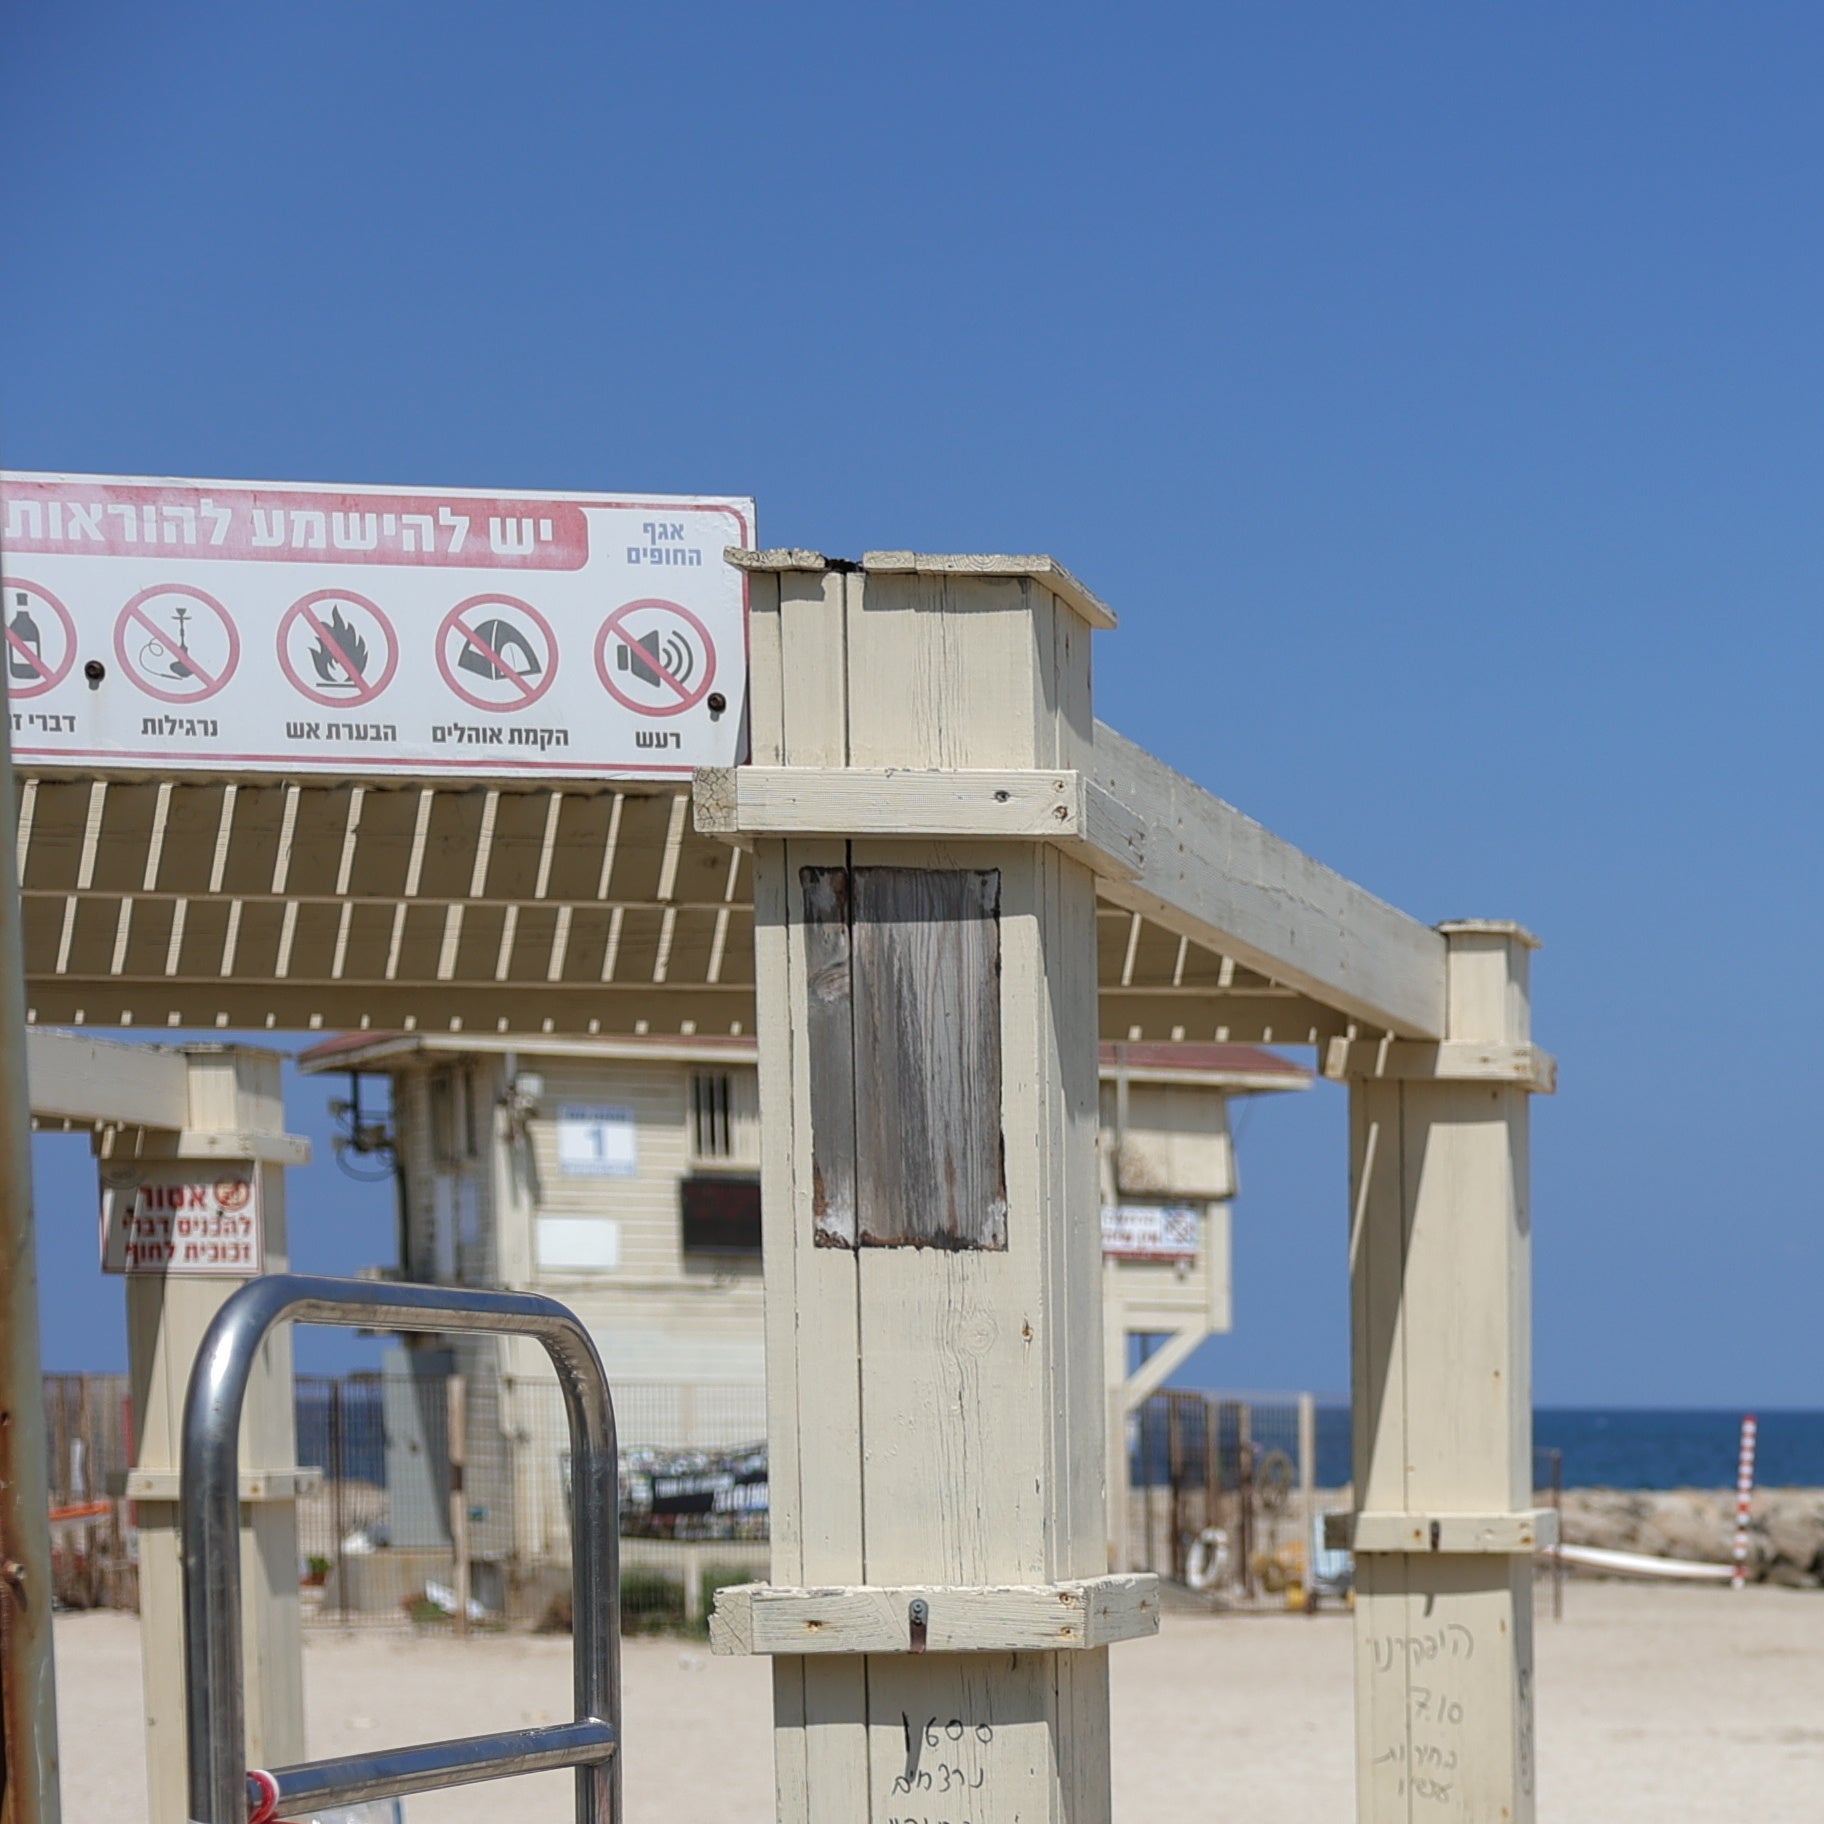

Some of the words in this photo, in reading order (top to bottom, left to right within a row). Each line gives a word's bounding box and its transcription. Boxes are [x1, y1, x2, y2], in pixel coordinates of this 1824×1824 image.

[4, 497, 233, 546] להוראות
[251, 506, 471, 554] להישמע
[488, 517, 553, 555] יש
[642, 522, 685, 546] אגף
[626, 547, 702, 566] החופים
[28, 713, 76, 732] דברי
[141, 714, 218, 737] נרגילות
[286, 721, 320, 740] אש
[326, 723, 397, 742] הבערת
[432, 722, 503, 745] אוהלים
[508, 727, 569, 751] הקמת
[635, 730, 681, 749] רעש
[587, 1122, 606, 1159] 1
[139, 1184, 206, 1209] אסור
[122, 1217, 169, 1237] דברי
[177, 1215, 251, 1238] להכניס
[125, 1240, 175, 1265] לחוף
[184, 1243, 251, 1262] זכוכית
[902, 1711, 993, 1753] 1600
